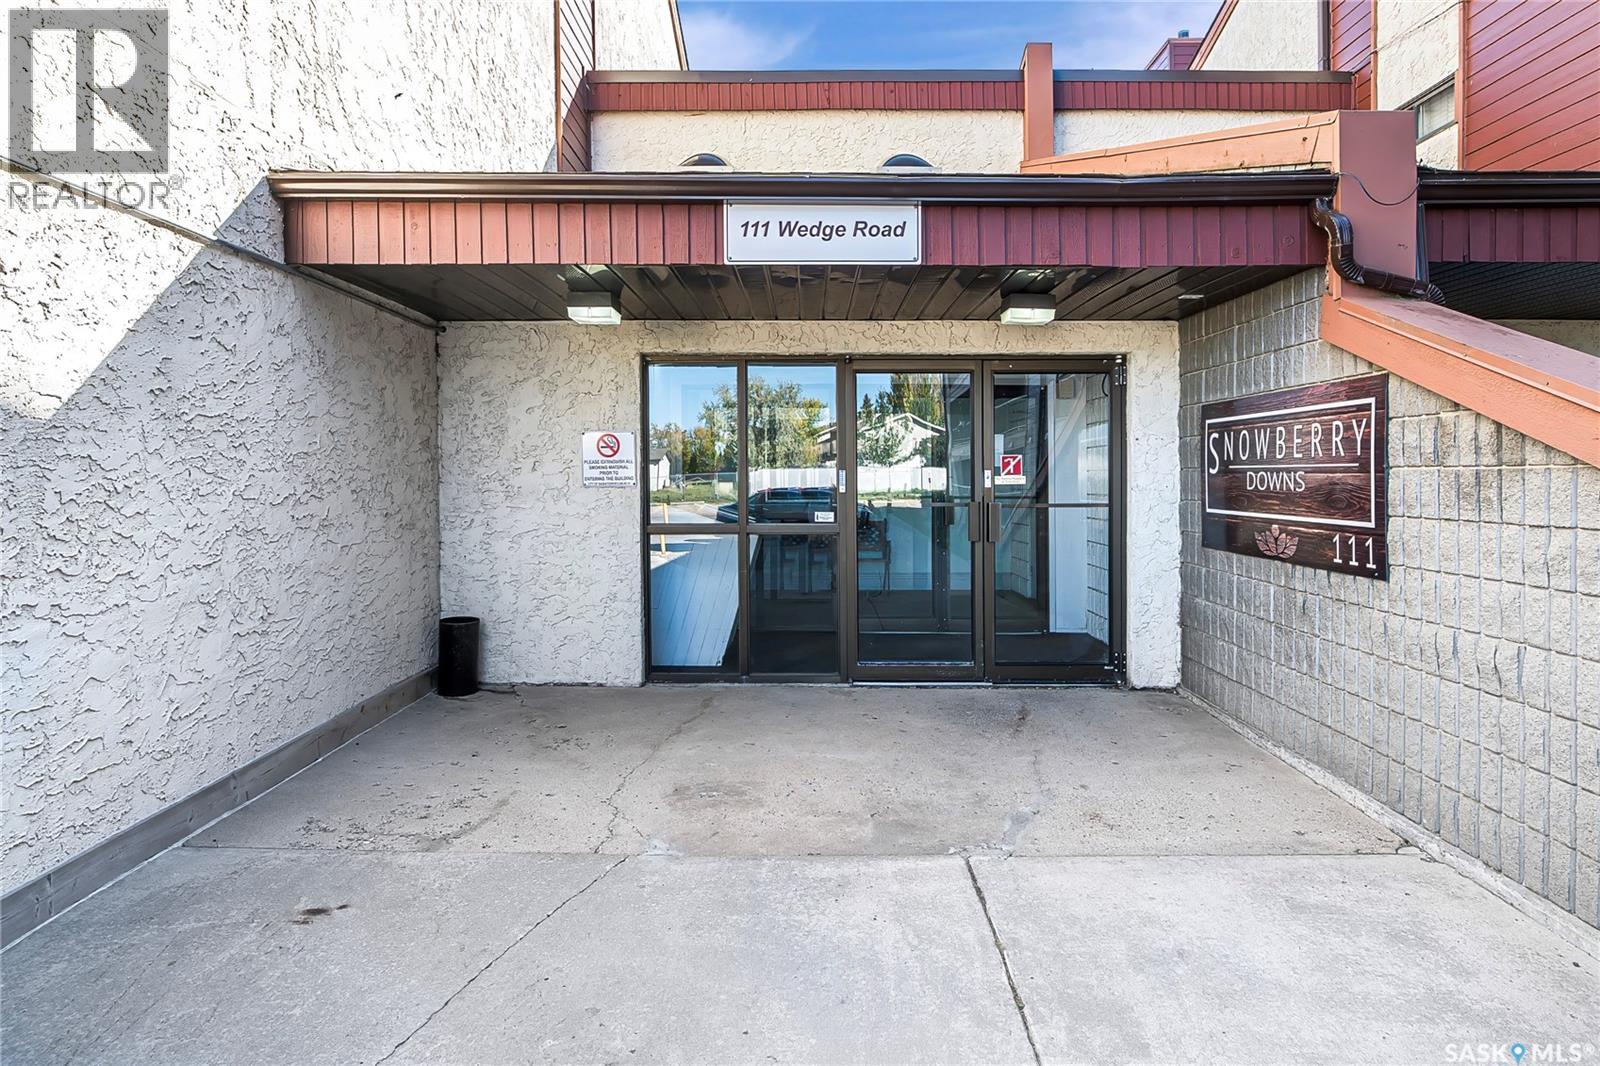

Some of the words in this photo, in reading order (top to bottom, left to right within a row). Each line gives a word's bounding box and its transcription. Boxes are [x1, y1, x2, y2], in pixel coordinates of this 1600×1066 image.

[740, 221, 770, 237] 111
[778, 221, 846, 241] Wedge
[853, 221, 907, 237] Road
[1208, 418, 1368, 475] SNOWBERRY
[1246, 471, 1306, 492] DOWNS
[1332, 533, 1377, 569] 111
